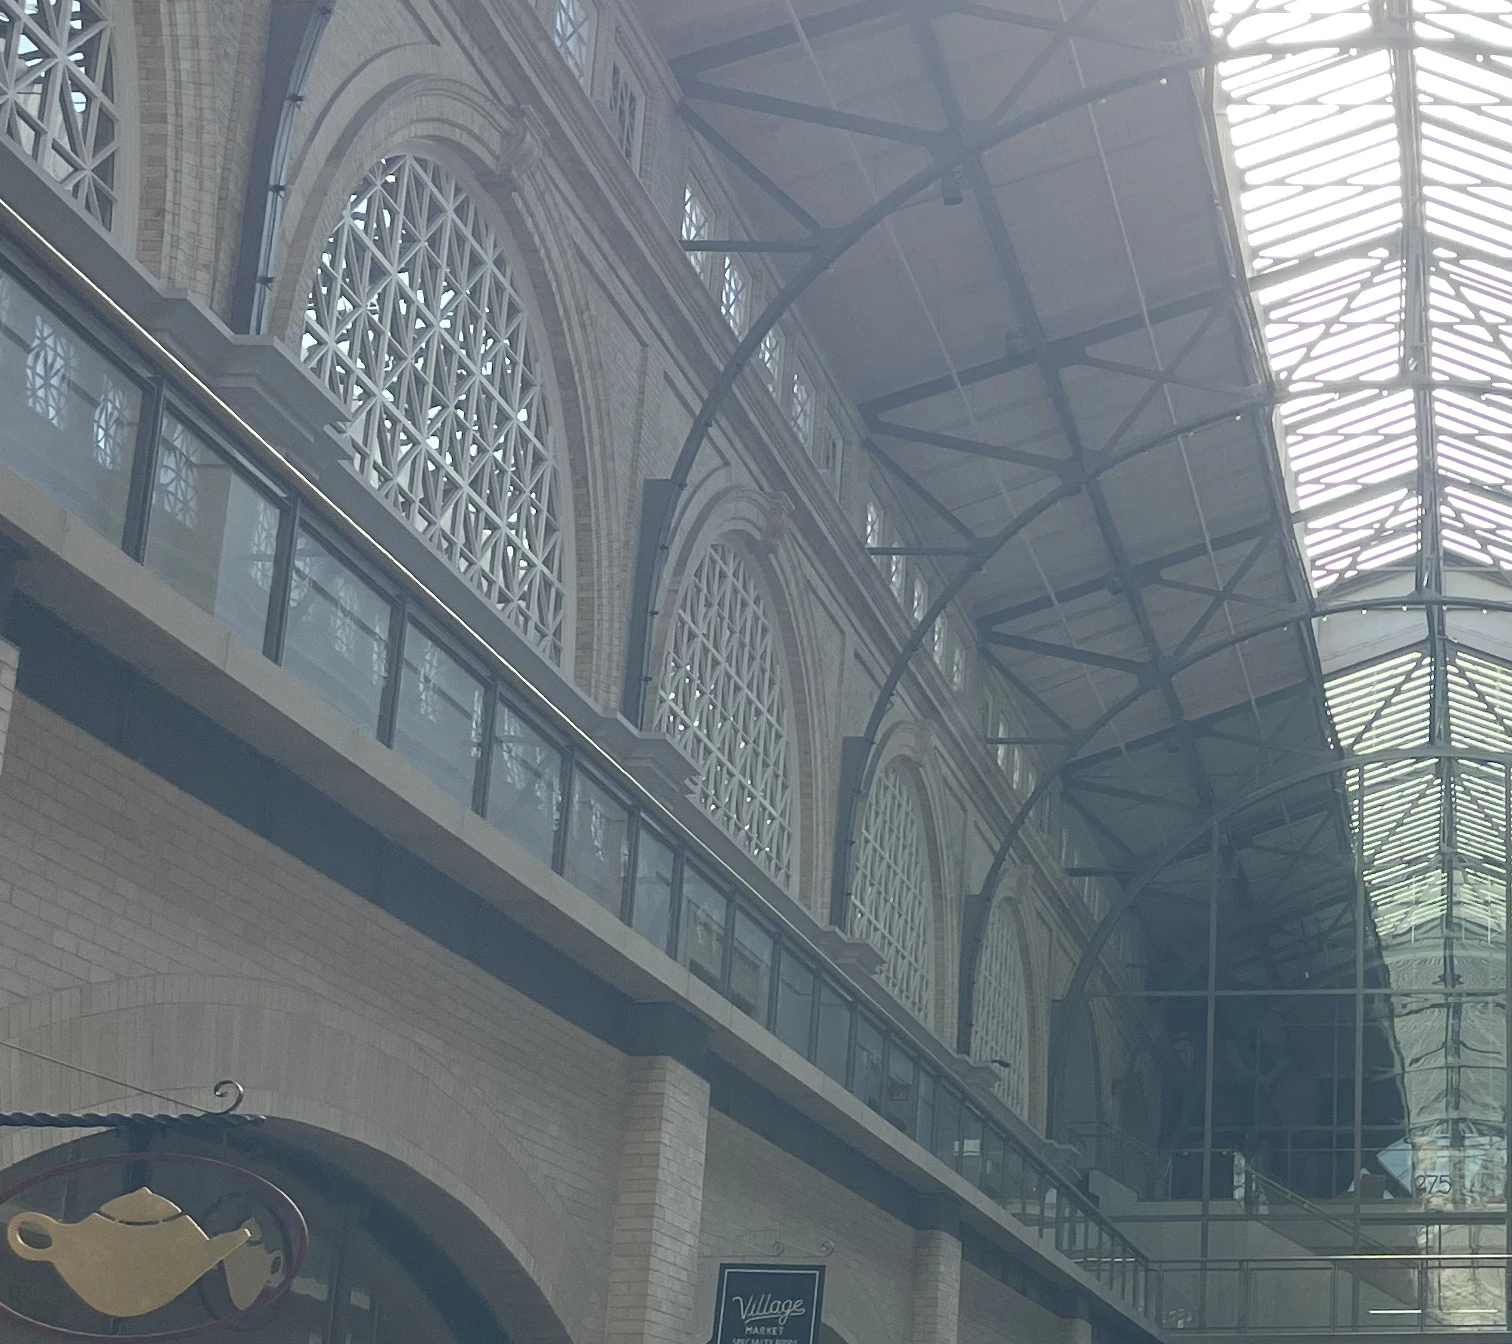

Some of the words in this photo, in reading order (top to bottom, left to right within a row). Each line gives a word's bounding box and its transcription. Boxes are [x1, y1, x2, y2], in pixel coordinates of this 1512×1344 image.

[1414, 1174, 1452, 1195] 275
[731, 1292, 806, 1325] Village
[744, 1326, 785, 1336] MARKET
